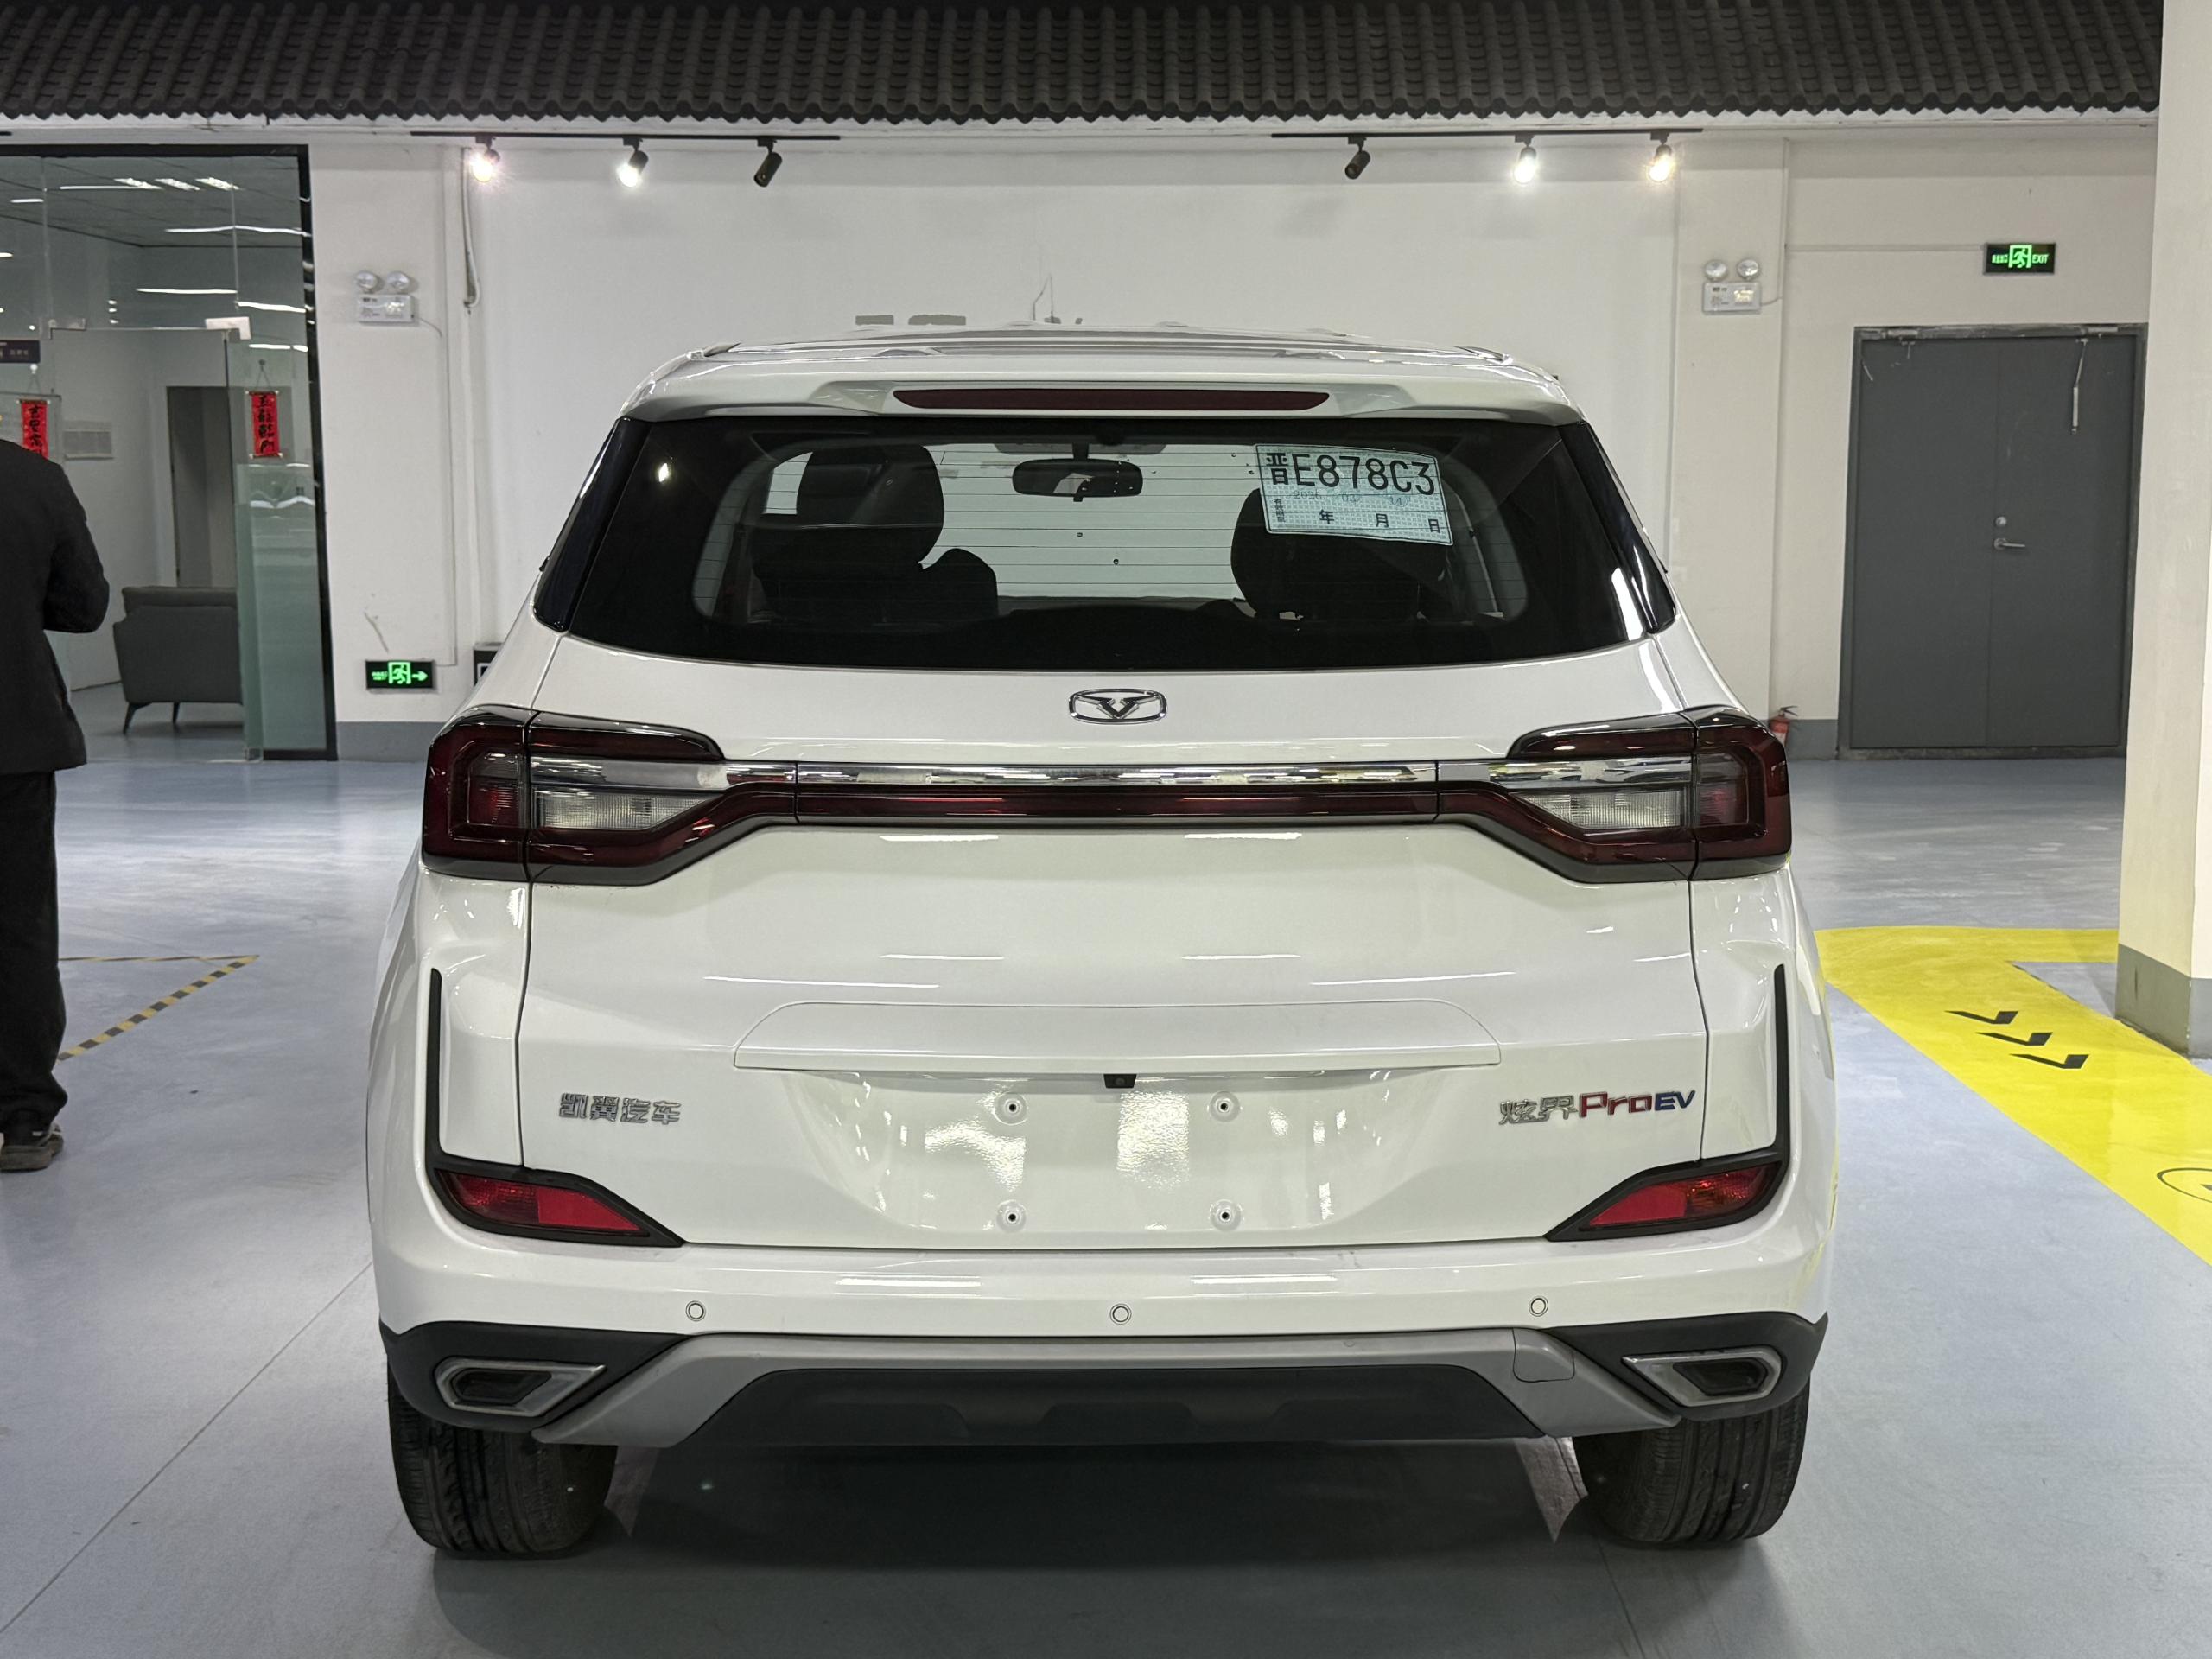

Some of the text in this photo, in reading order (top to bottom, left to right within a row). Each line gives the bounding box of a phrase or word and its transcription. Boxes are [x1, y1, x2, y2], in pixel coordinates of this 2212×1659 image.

[2031, 253, 2049, 264] EXIT
[1266, 452, 1435, 496] 晋E878C3
[1319, 509, 1441, 534] 年 月 日
[559, 1092, 681, 1125] 凯翼汽车
